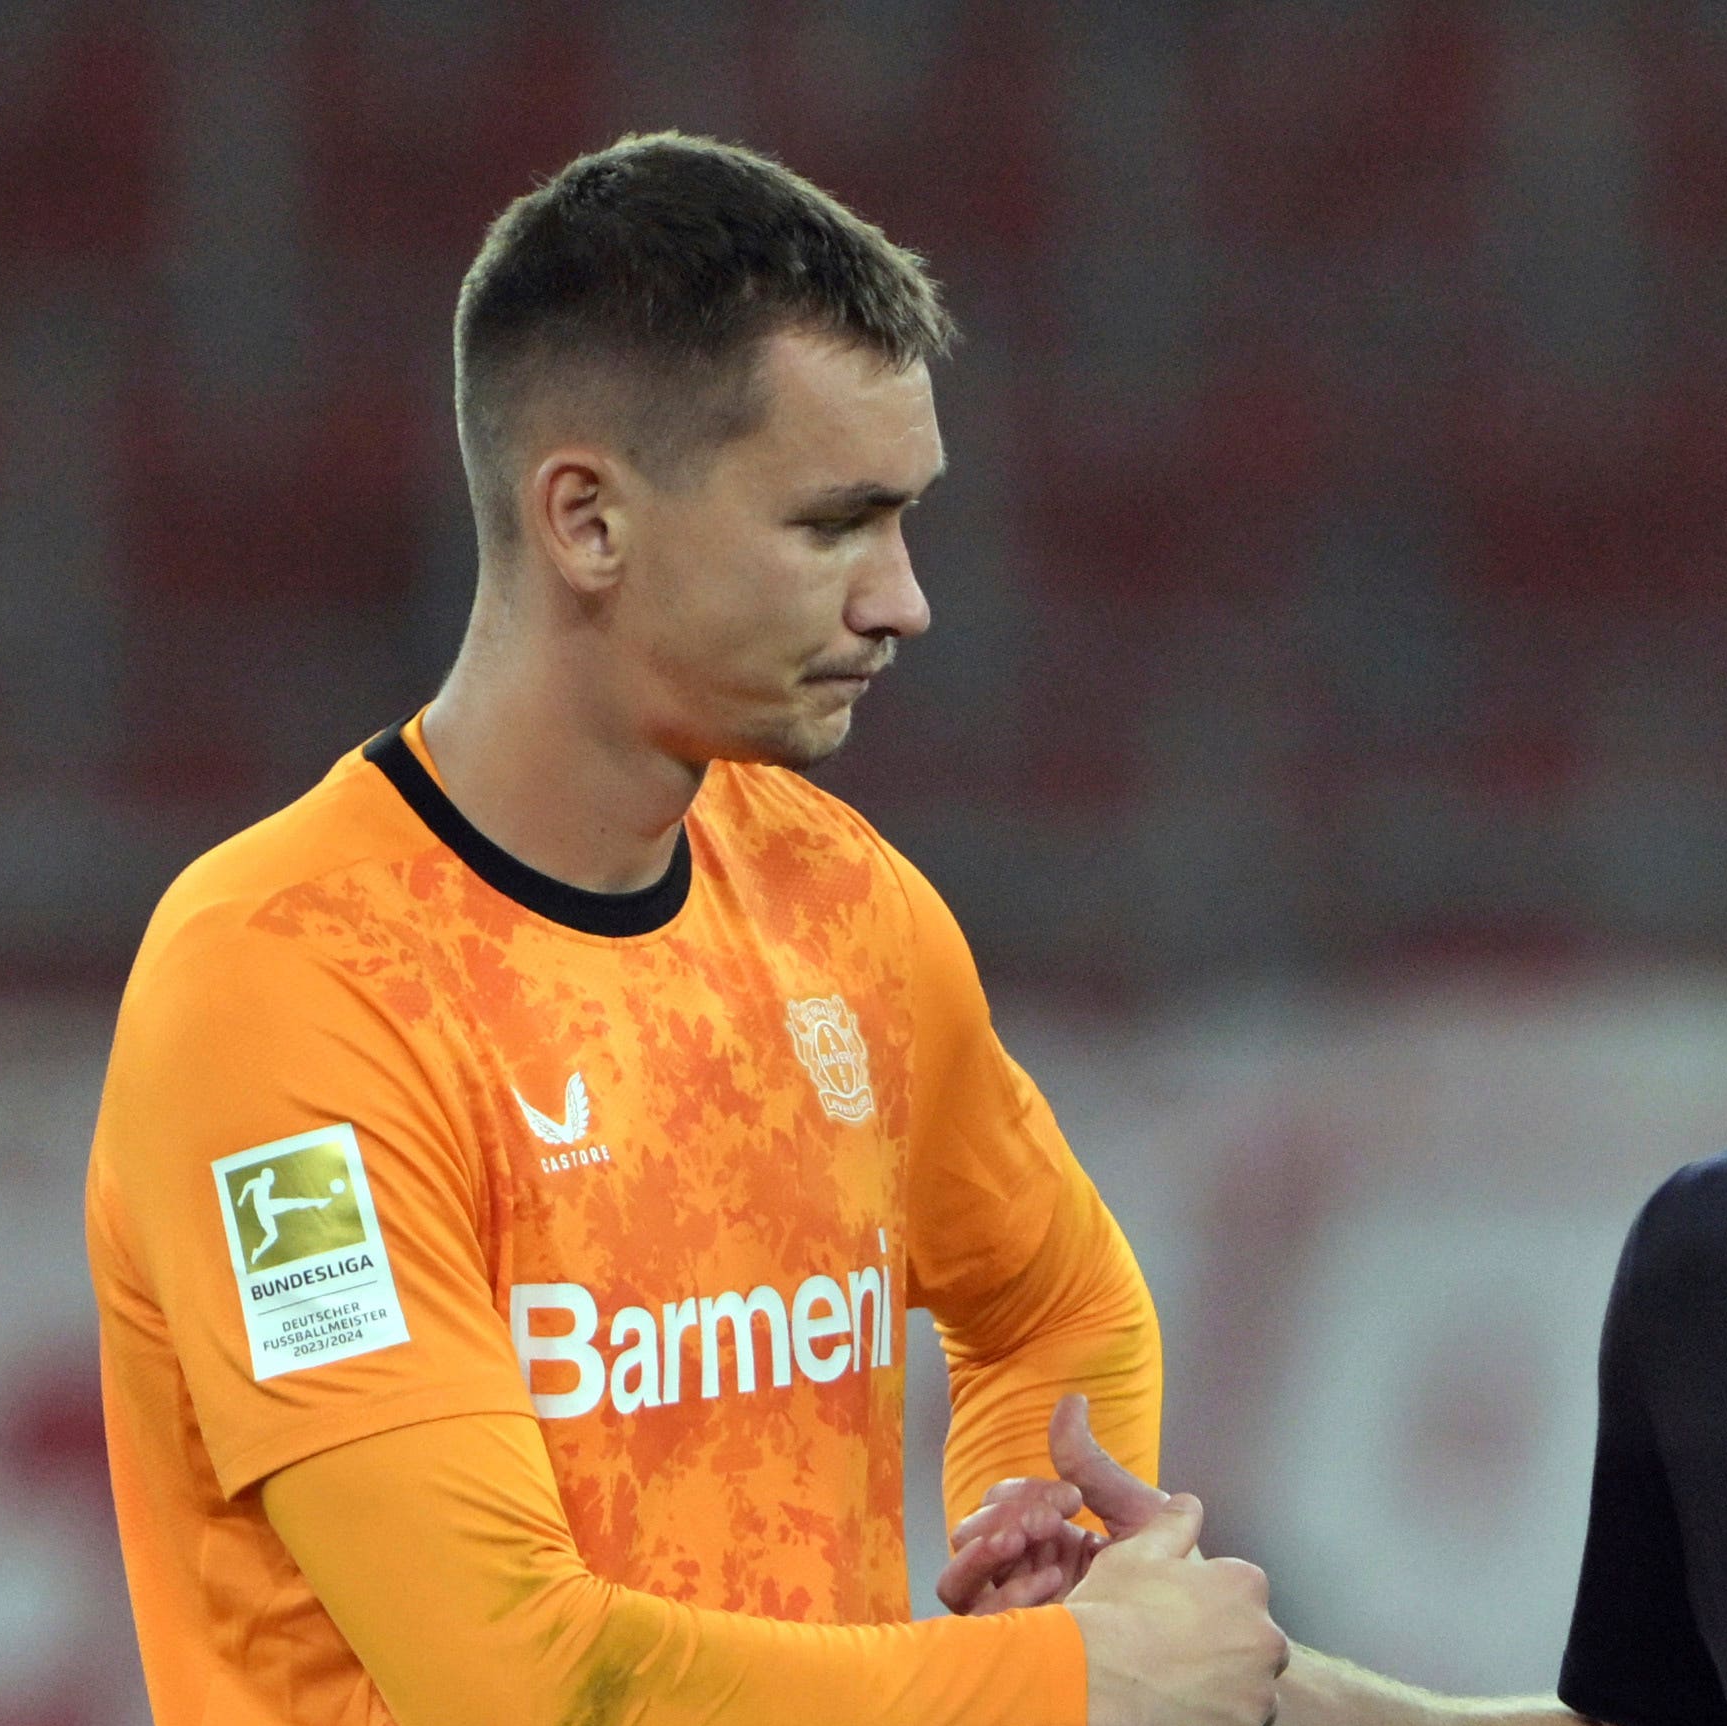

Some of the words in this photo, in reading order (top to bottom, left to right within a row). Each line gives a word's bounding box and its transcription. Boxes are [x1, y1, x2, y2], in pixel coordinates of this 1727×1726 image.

[540, 1144, 611, 1174] CASTORE
[250, 1253, 375, 1302] BUNDESLIGA
[263, 1308, 388, 1352] FUSSBALLMEISTER
[282, 1301, 361, 1333] DEUTSCHER
[509, 1227, 892, 1420] Barmeni
[293, 1329, 364, 1358] 2023/2024
